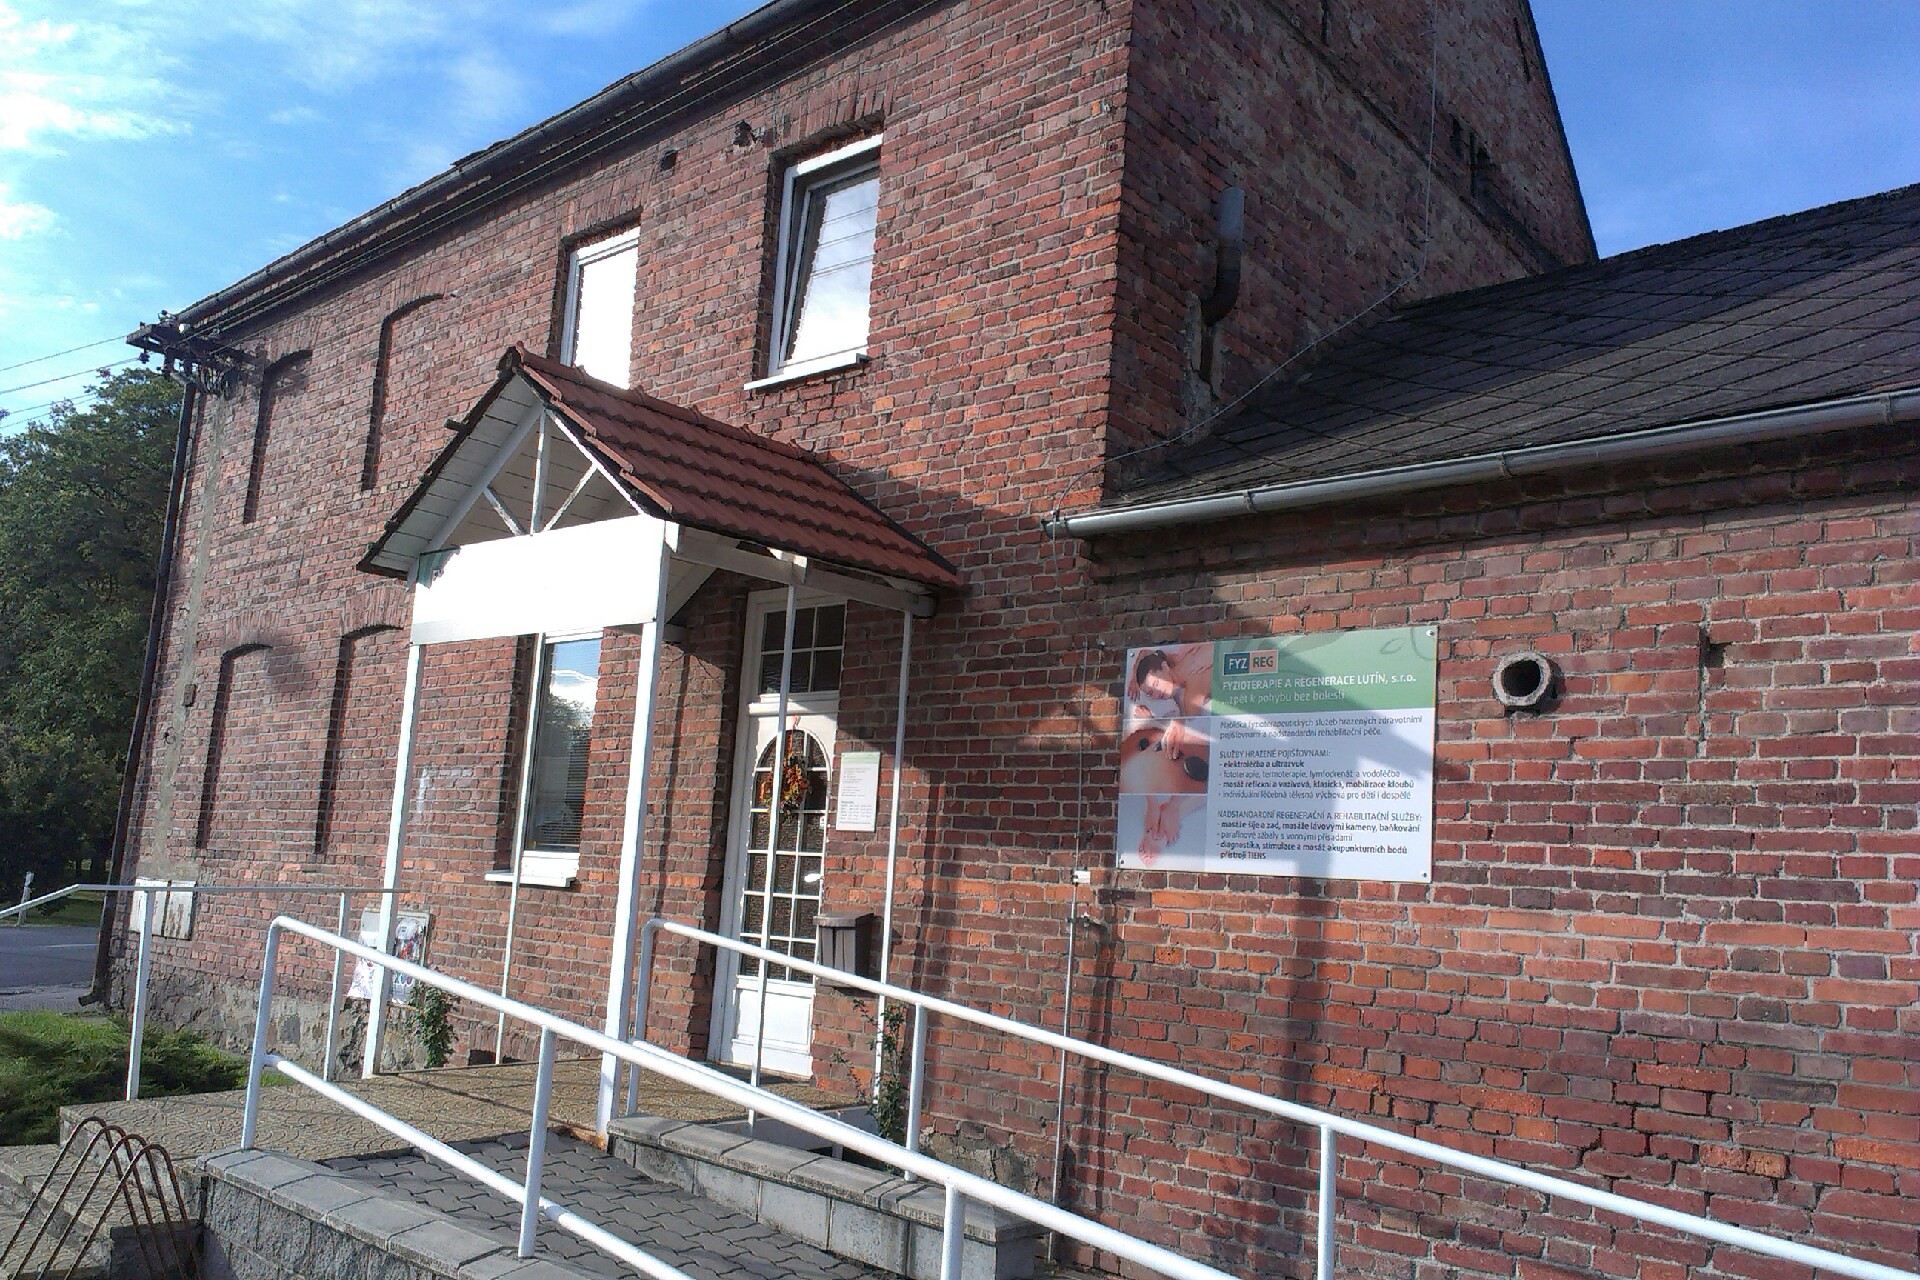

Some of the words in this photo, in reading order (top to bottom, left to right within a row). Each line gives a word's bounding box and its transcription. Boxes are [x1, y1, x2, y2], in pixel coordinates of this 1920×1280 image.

[1228, 658, 1248, 670] FYZ
[1252, 656, 1274, 668] REG
[1222, 679, 1282, 690] FYZIOTERAPIE
[1284, 678, 1292, 688] A
[1294, 676, 1354, 687] REGENERACE
[1357, 672, 1388, 684] LUTÍN,
[1391, 673, 1416, 683] s.r.o.
[1250, 694, 1256, 703] k
[1257, 693, 1291, 704] pohybu
[1294, 692, 1310, 701] bez
[1312, 689, 1345, 700] bolesti
[1316, 718, 1337, 726] služeb
[1379, 716, 1422, 724] zdravotními
[1318, 728, 1361, 736] rehabilitační
[1364, 728, 1382, 736] péče.
[1220, 750, 1244, 758] SLUŽBY
[1310, 770, 1353, 779] lymfodrenáž
[1314, 781, 1344, 789] klasická,
[1388, 780, 1414, 788] kloubů
[1316, 791, 1345, 800] výchova
[1381, 792, 1411, 800] dospělé
[1276, 810, 1324, 819] REGENERAČNÍ
[1334, 811, 1389, 820] REHABILITAČNÍ
[1391, 812, 1422, 821] SLUŽBY:
[1267, 822, 1280, 830] zad,
[1311, 823, 1344, 832] lávovými
[1346, 823, 1378, 833] kameny,
[1380, 823, 1420, 832] baňkování
[1258, 832, 1279, 840] zábaly
[1287, 833, 1316, 841] vonnými
[1327, 844, 1385, 853] akupunkturních
[1387, 845, 1407, 854] bodů
